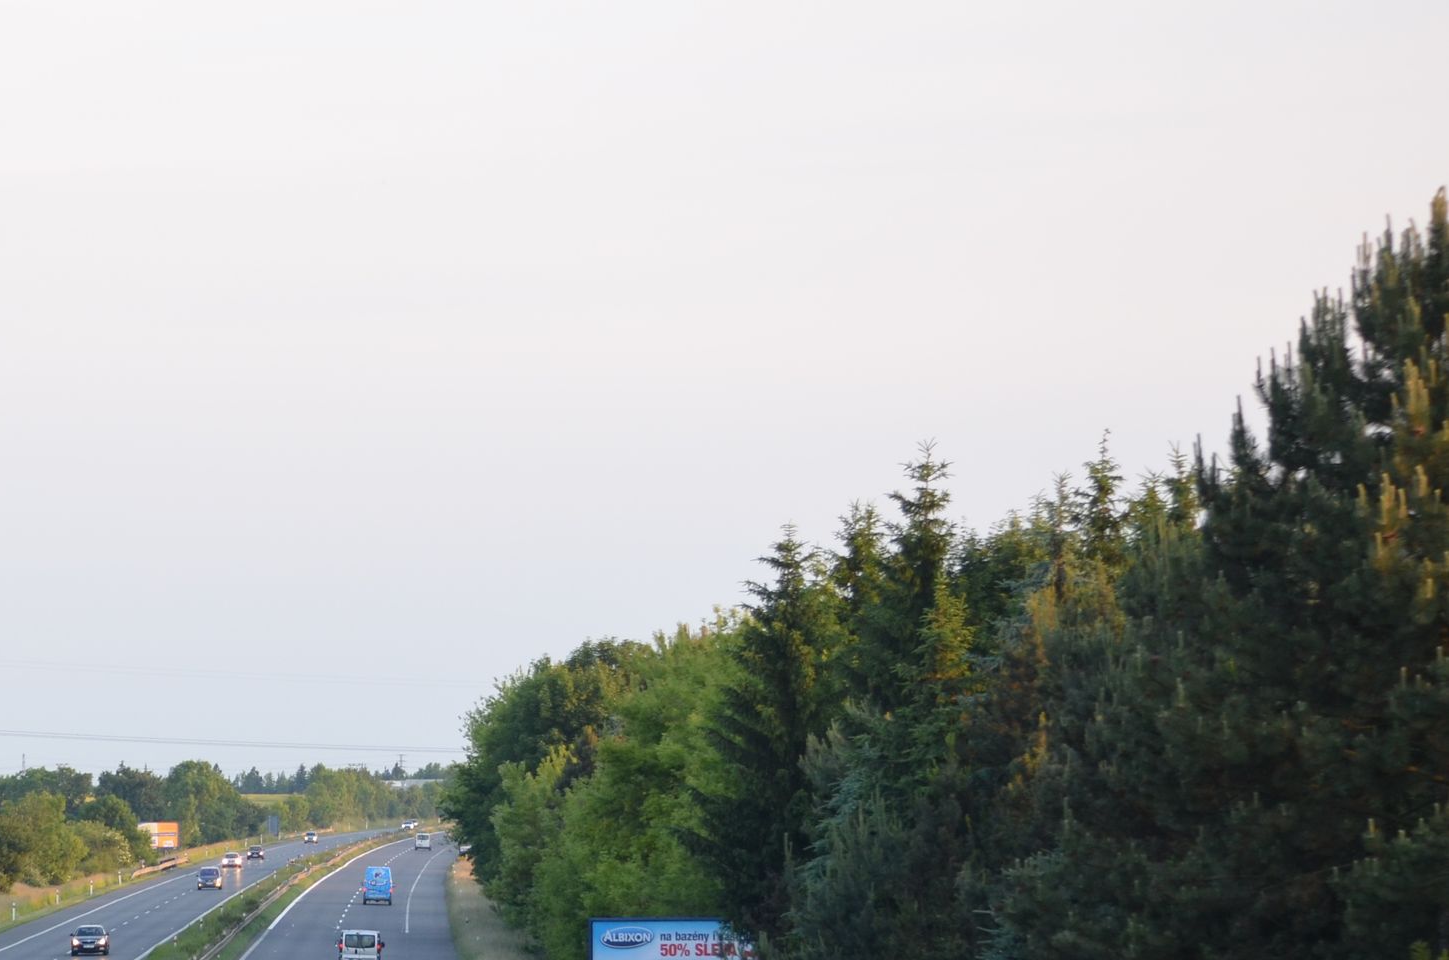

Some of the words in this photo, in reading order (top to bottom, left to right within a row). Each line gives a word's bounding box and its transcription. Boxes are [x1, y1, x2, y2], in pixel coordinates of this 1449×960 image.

[603, 929, 652, 943] ALBIXON
[660, 932, 672, 941] na
[675, 931, 709, 942] bazény
[660, 943, 691, 956] 50%
